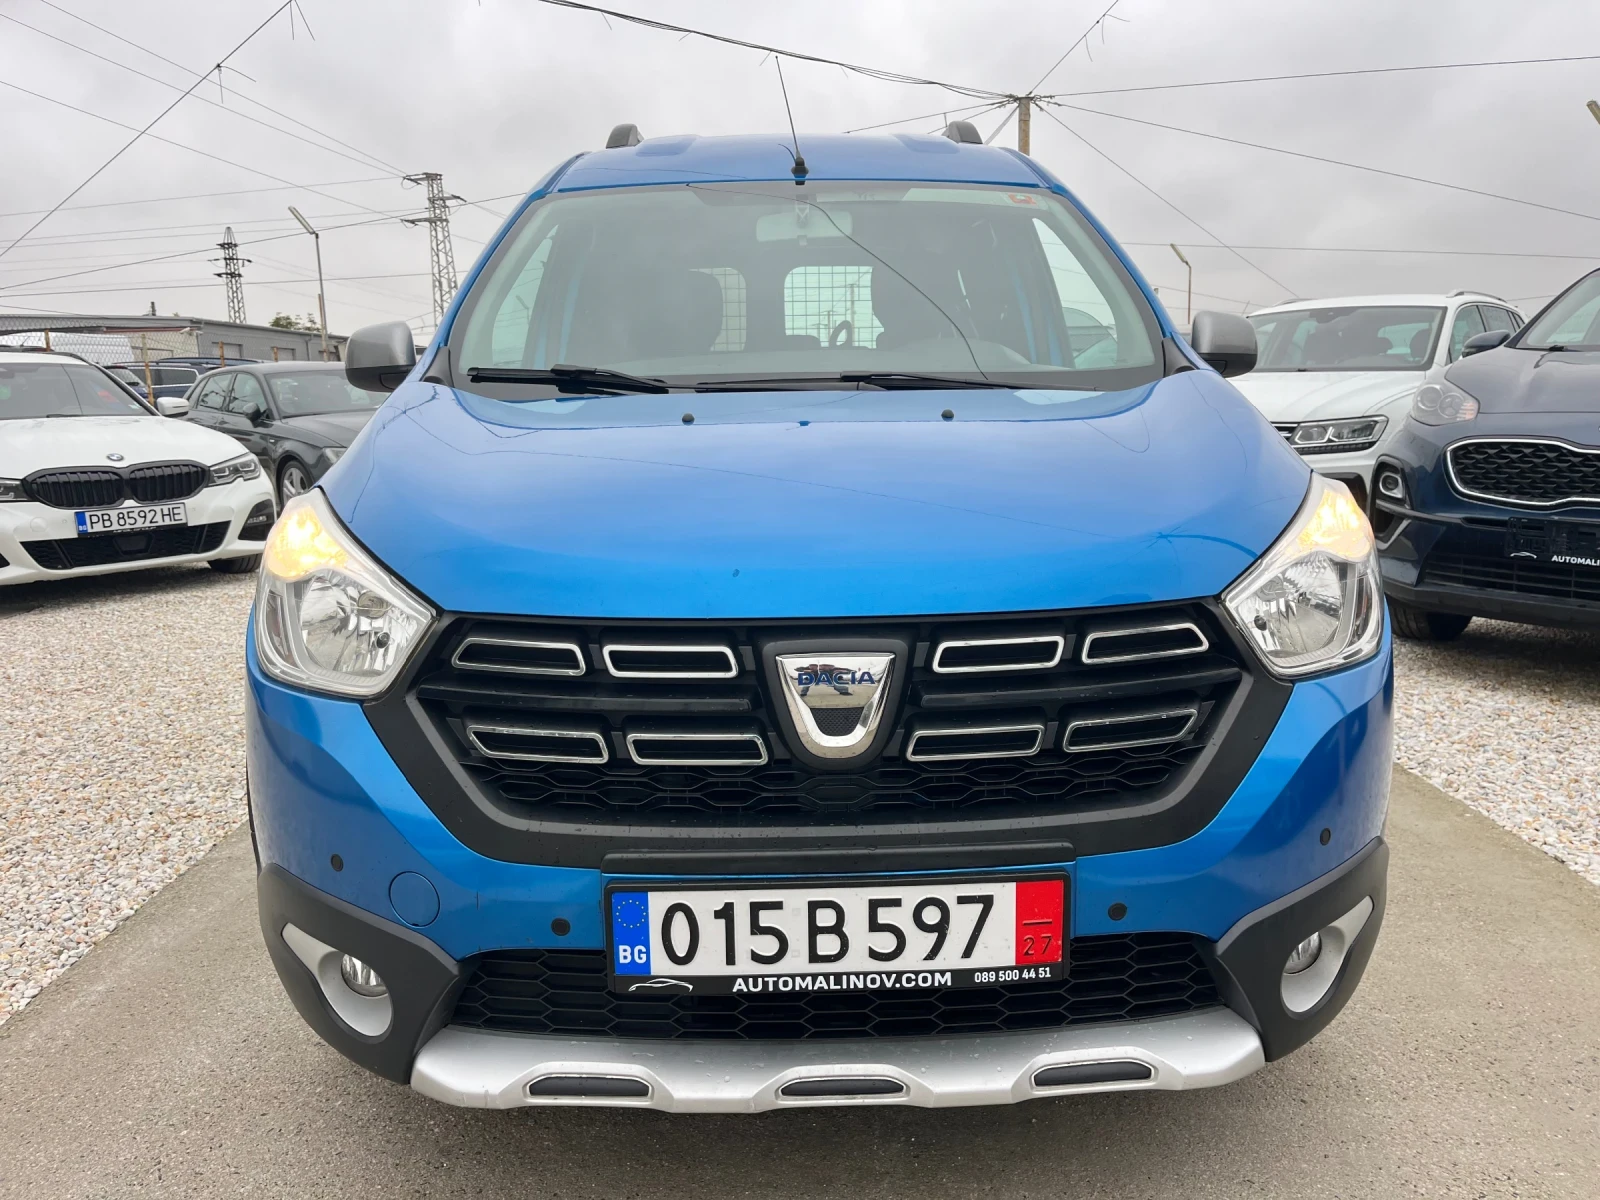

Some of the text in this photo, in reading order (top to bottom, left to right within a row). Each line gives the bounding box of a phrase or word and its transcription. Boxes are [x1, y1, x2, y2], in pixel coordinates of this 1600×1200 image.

[89, 513, 113, 530] PB
[117, 508, 159, 527] 8592
[160, 506, 183, 523] HE
[798, 671, 876, 686] DACIA
[618, 944, 647, 964] BG
[1023, 934, 1053, 957] 27
[732, 972, 952, 992] AUTOMALINOV.COM
[974, 967, 1052, 983] 089 500 44 51
